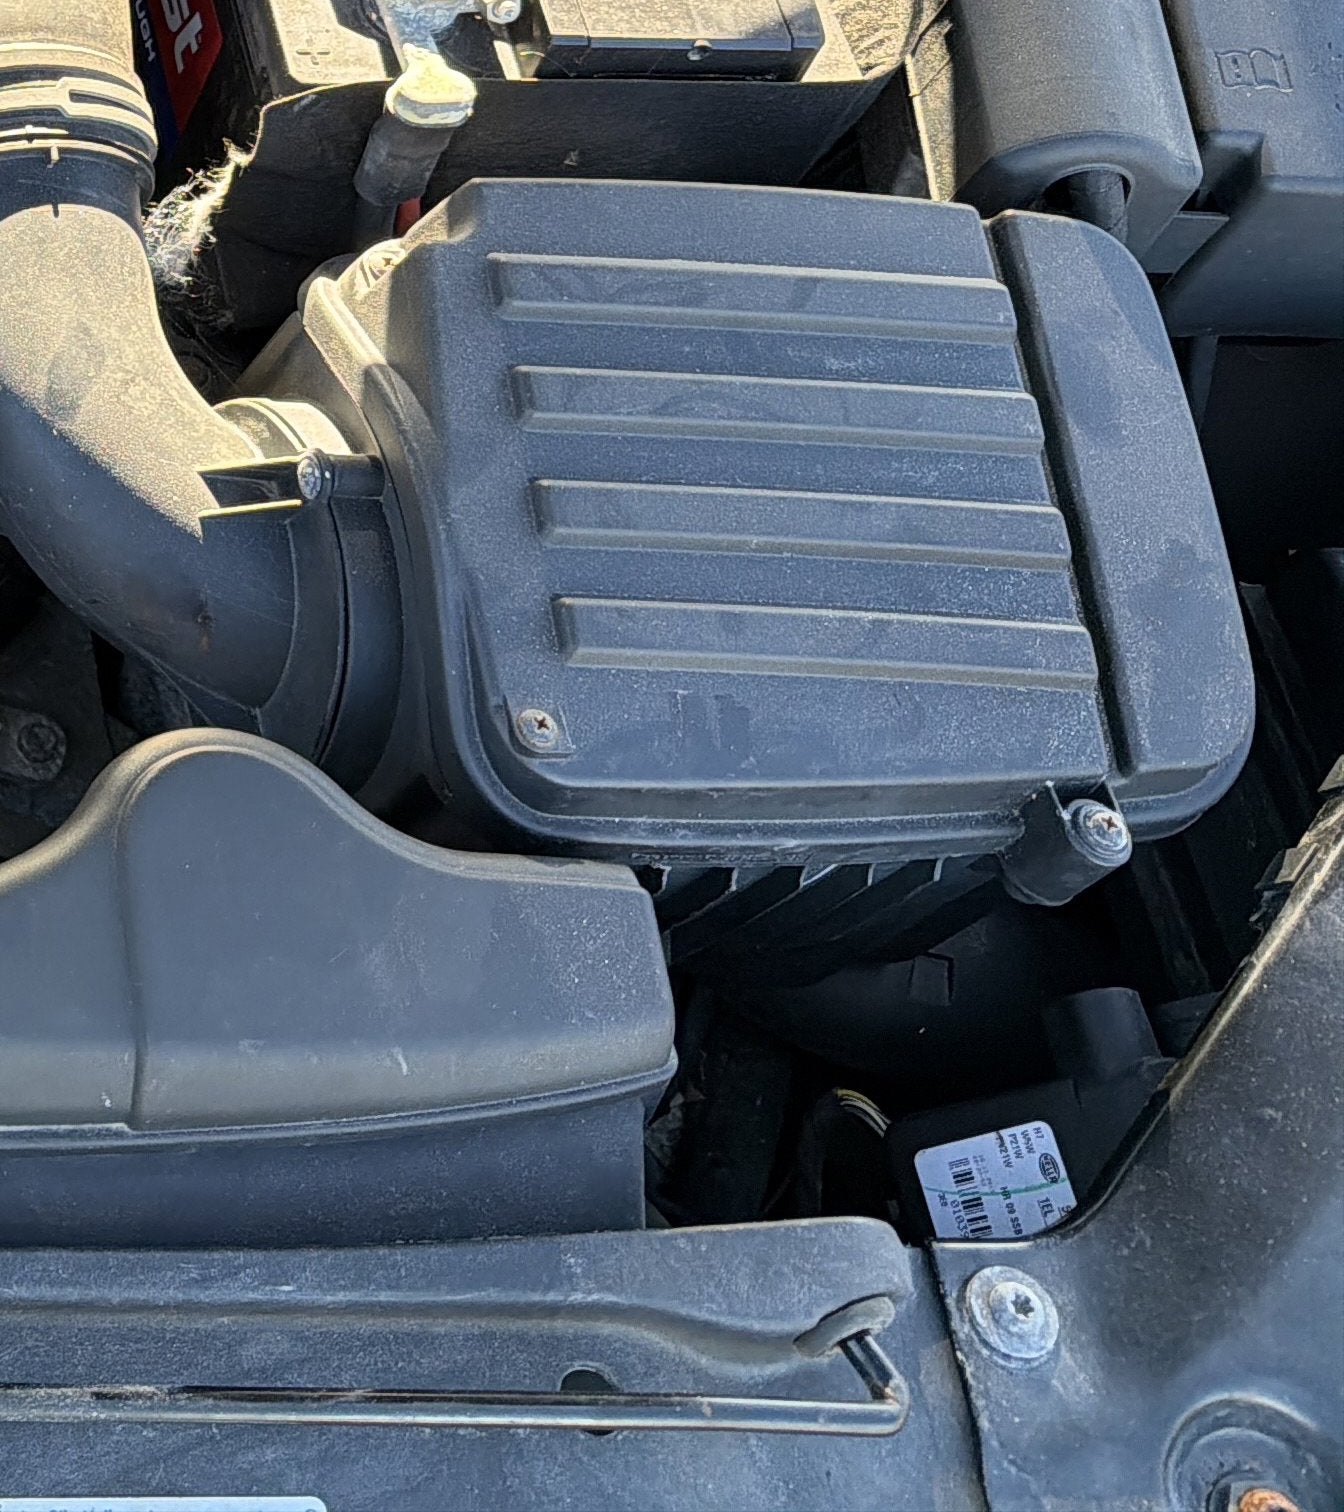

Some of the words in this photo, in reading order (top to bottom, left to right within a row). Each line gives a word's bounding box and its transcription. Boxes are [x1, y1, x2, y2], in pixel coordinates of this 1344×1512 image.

[1007, 1132, 1023, 1158] P21W
[1020, 1129, 1035, 1154] W5W
[1033, 1126, 1044, 1139] H7
